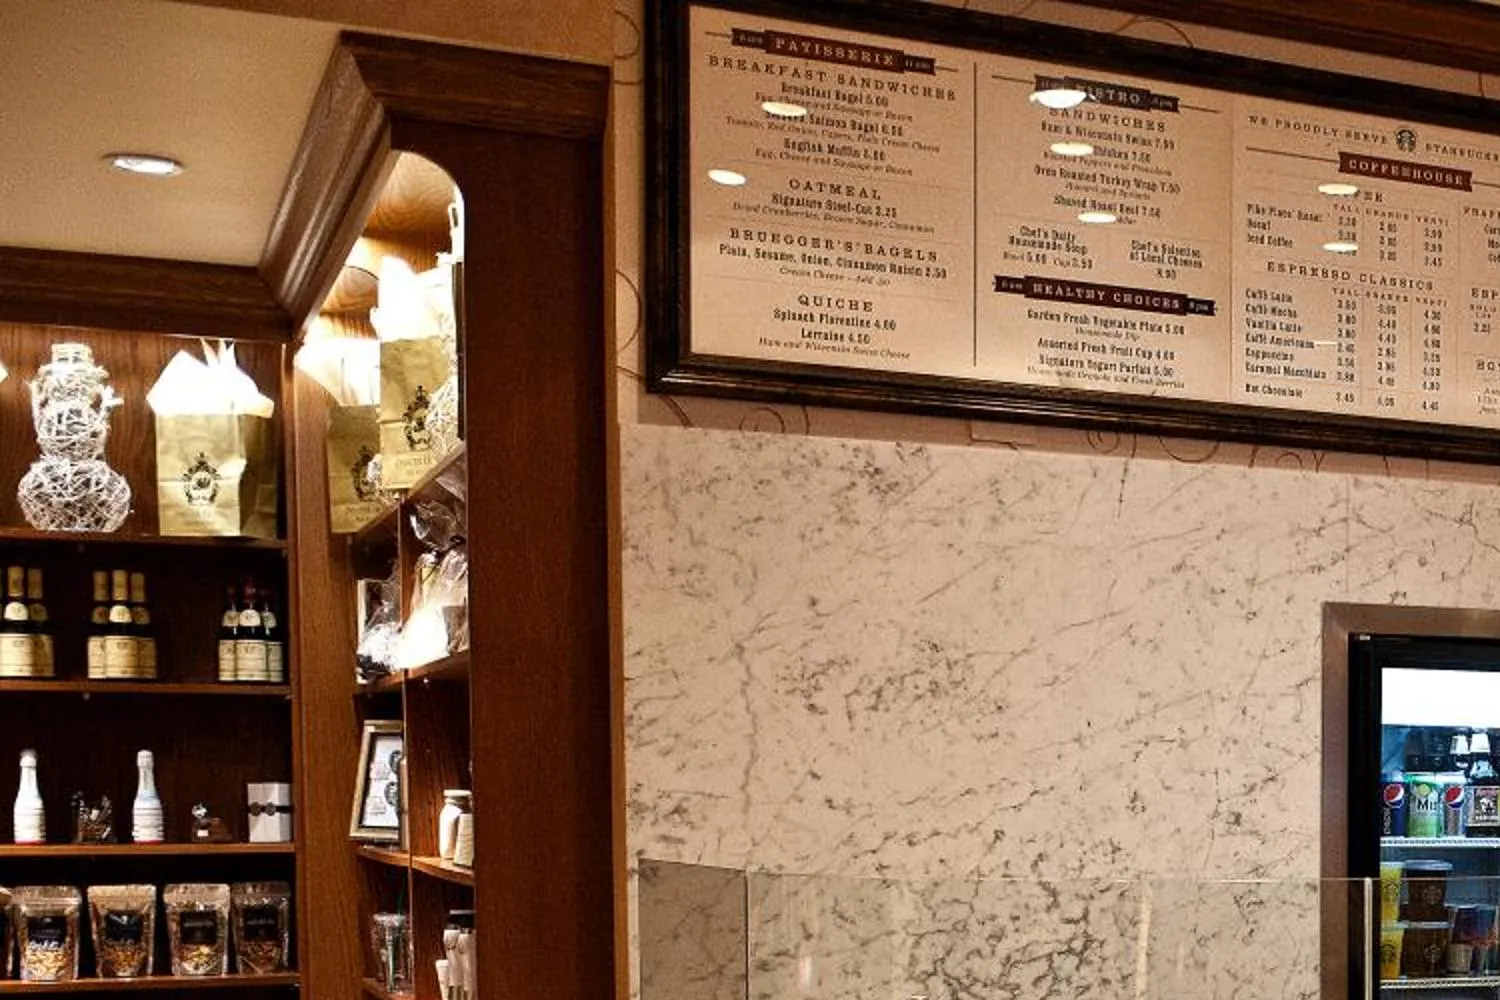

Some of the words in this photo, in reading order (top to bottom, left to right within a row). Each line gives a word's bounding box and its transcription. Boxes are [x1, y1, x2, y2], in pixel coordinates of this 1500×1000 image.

[775, 36, 895, 67] PATISSERIE
[709, 53, 825, 82] BREAKFAST
[837, 73, 955, 101] SANDWICHES
[781, 81, 830, 99] Breakfast
[850, 119, 878, 134] Bagel
[1049, 104, 1165, 132] SANDWICHES
[1275, 119, 1338, 137] PROUDLY
[784, 137, 822, 154] English
[827, 143, 860, 157] Muffin
[1100, 173, 1131, 188] Turkey
[1348, 159, 1462, 185] COFFEEHOUSE
[789, 178, 880, 200] OATMEAL
[771, 193, 822, 210] Signature
[865, 243, 936, 262] BAGELS
[1267, 261, 1350, 281] ESPRESSO
[1360, 273, 1433, 291] CLASSICS
[798, 294, 872, 313] QUICHE
[1033, 282, 1104, 300] HEALTHY
[1113, 291, 1179, 309] CHOICES
[773, 308, 814, 323] Spinach
[819, 312, 870, 327] Florentine
[1063, 313, 1089, 325] Fresh
[801, 328, 843, 342] Lorraine
[1037, 337, 1078, 350] Assorted
[1081, 342, 1105, 353] Fresh
